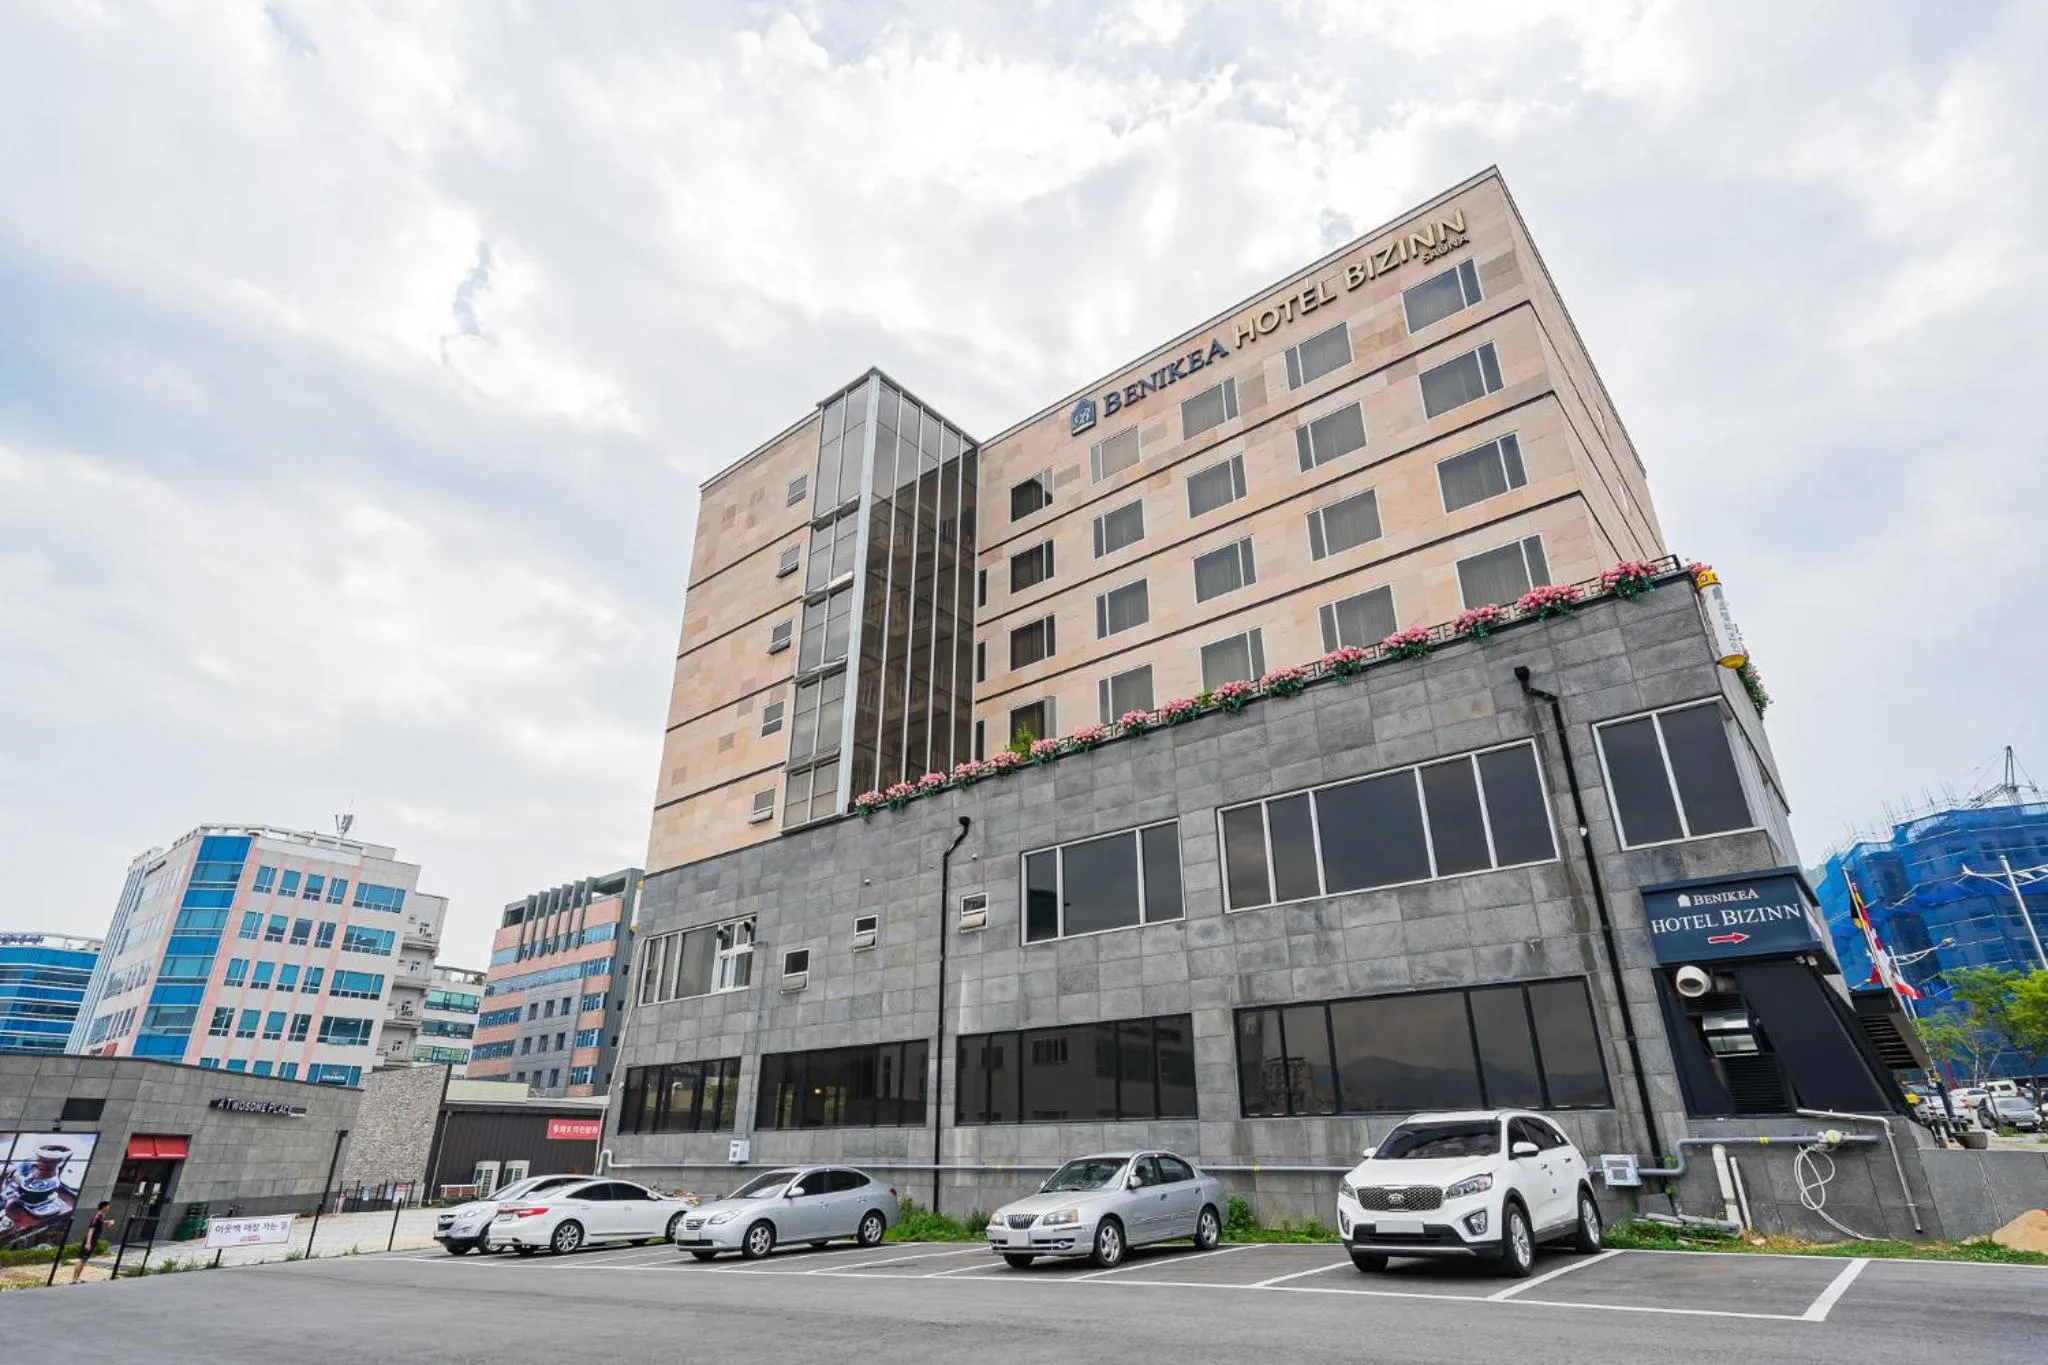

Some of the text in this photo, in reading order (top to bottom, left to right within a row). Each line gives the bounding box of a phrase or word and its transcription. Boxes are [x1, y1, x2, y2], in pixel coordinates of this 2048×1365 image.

[1422, 234, 1470, 266] SAUNA
[1103, 208, 1466, 418] BENIKEA HOTEL BIZINN
[1692, 888, 1760, 906] BENIKEA
[1652, 903, 1801, 934] HOTEL BIZINN
[226, 1098, 267, 1112] TWOSOME
